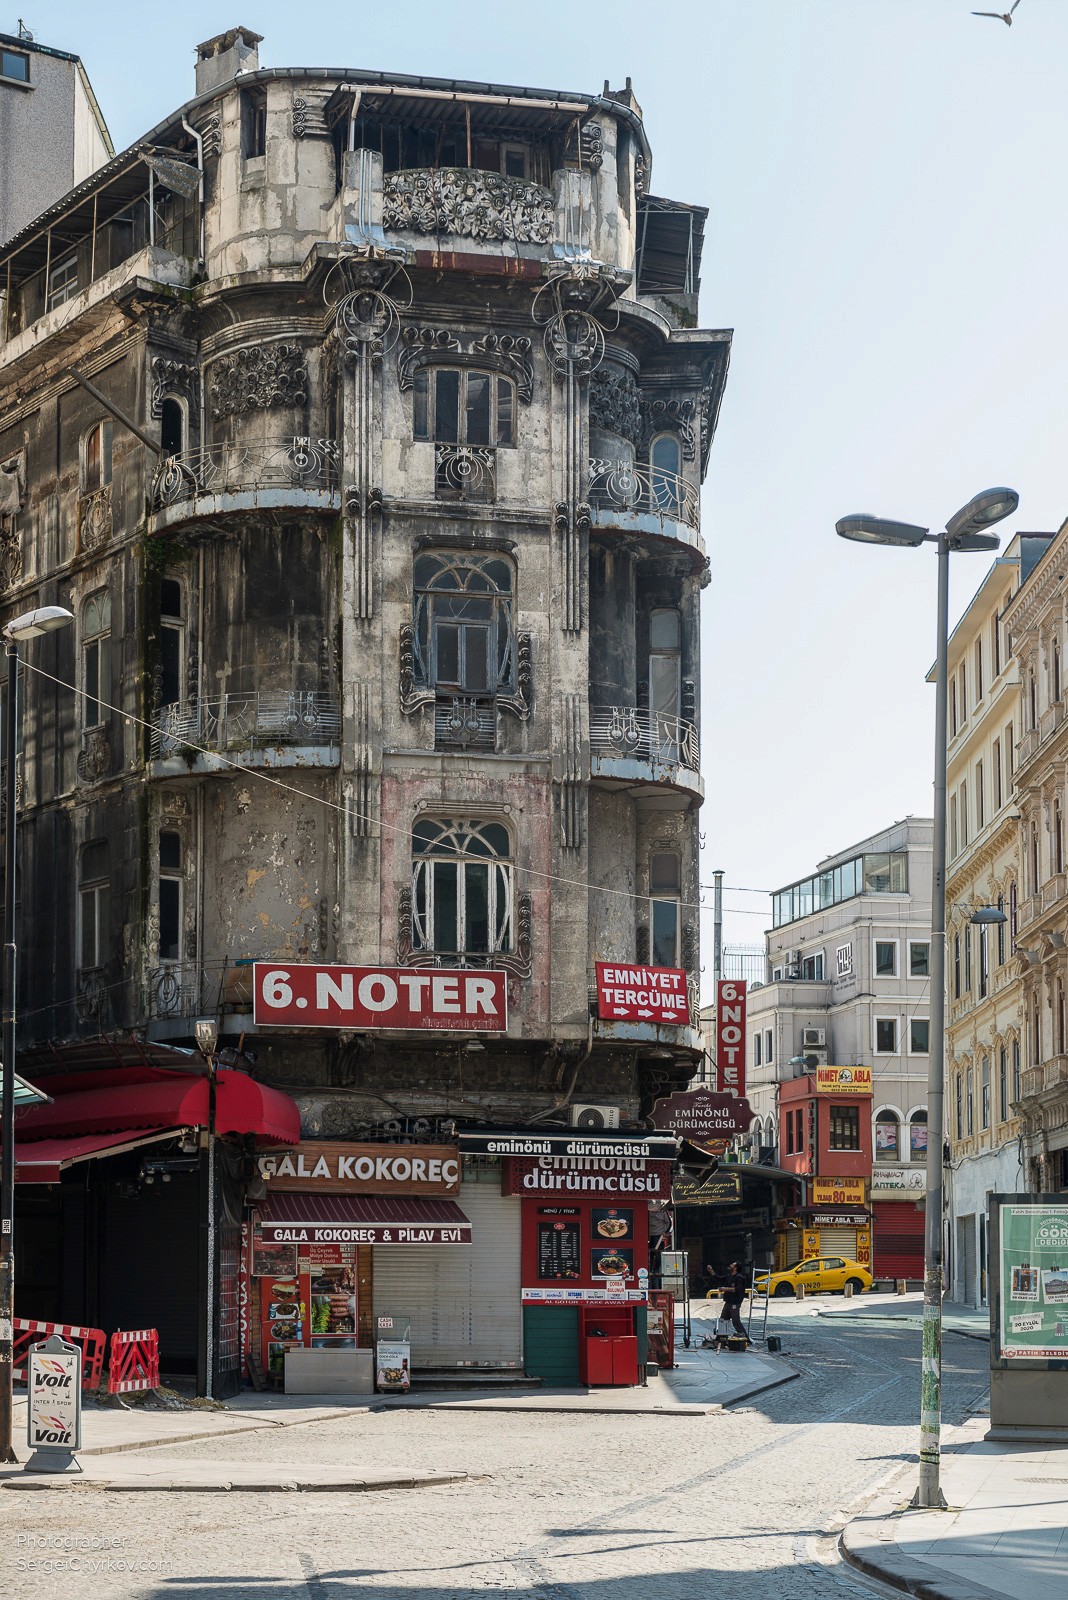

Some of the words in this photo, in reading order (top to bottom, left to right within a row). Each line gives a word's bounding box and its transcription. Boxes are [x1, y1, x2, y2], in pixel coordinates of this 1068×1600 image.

[603, 968, 681, 989] EMNİYET
[601, 988, 686, 1010] TERCÜME
[817, 1069, 838, 1083] NİMET
[853, 1070, 871, 1083] ABLA
[675, 1108, 729, 1117] EMİNÖNÜ
[669, 1119, 736, 1128] DÜRÜMCÜSÜ
[487, 1140, 551, 1153] eminönü
[567, 1142, 650, 1156] dürümcüsü
[257, 1155, 332, 1178] GALA
[338, 1156, 458, 1189] KOKOREÇ
[523, 1168, 661, 1192] dürümcüsü
[844, 1179, 859, 1188] ABLA
[833, 1191, 845, 1203] 80
[274, 1229, 308, 1241] GALA
[315, 1229, 375, 1243] KOKOREÇ
[382, 1230, 392, 1241] &
[399, 1227, 434, 1241] PİLAV
[441, 1227, 461, 1241] EVİ
[858, 1250, 869, 1262] 80
[36, 1374, 72, 1387] Voit
[35, 1430, 71, 1443] Voit
